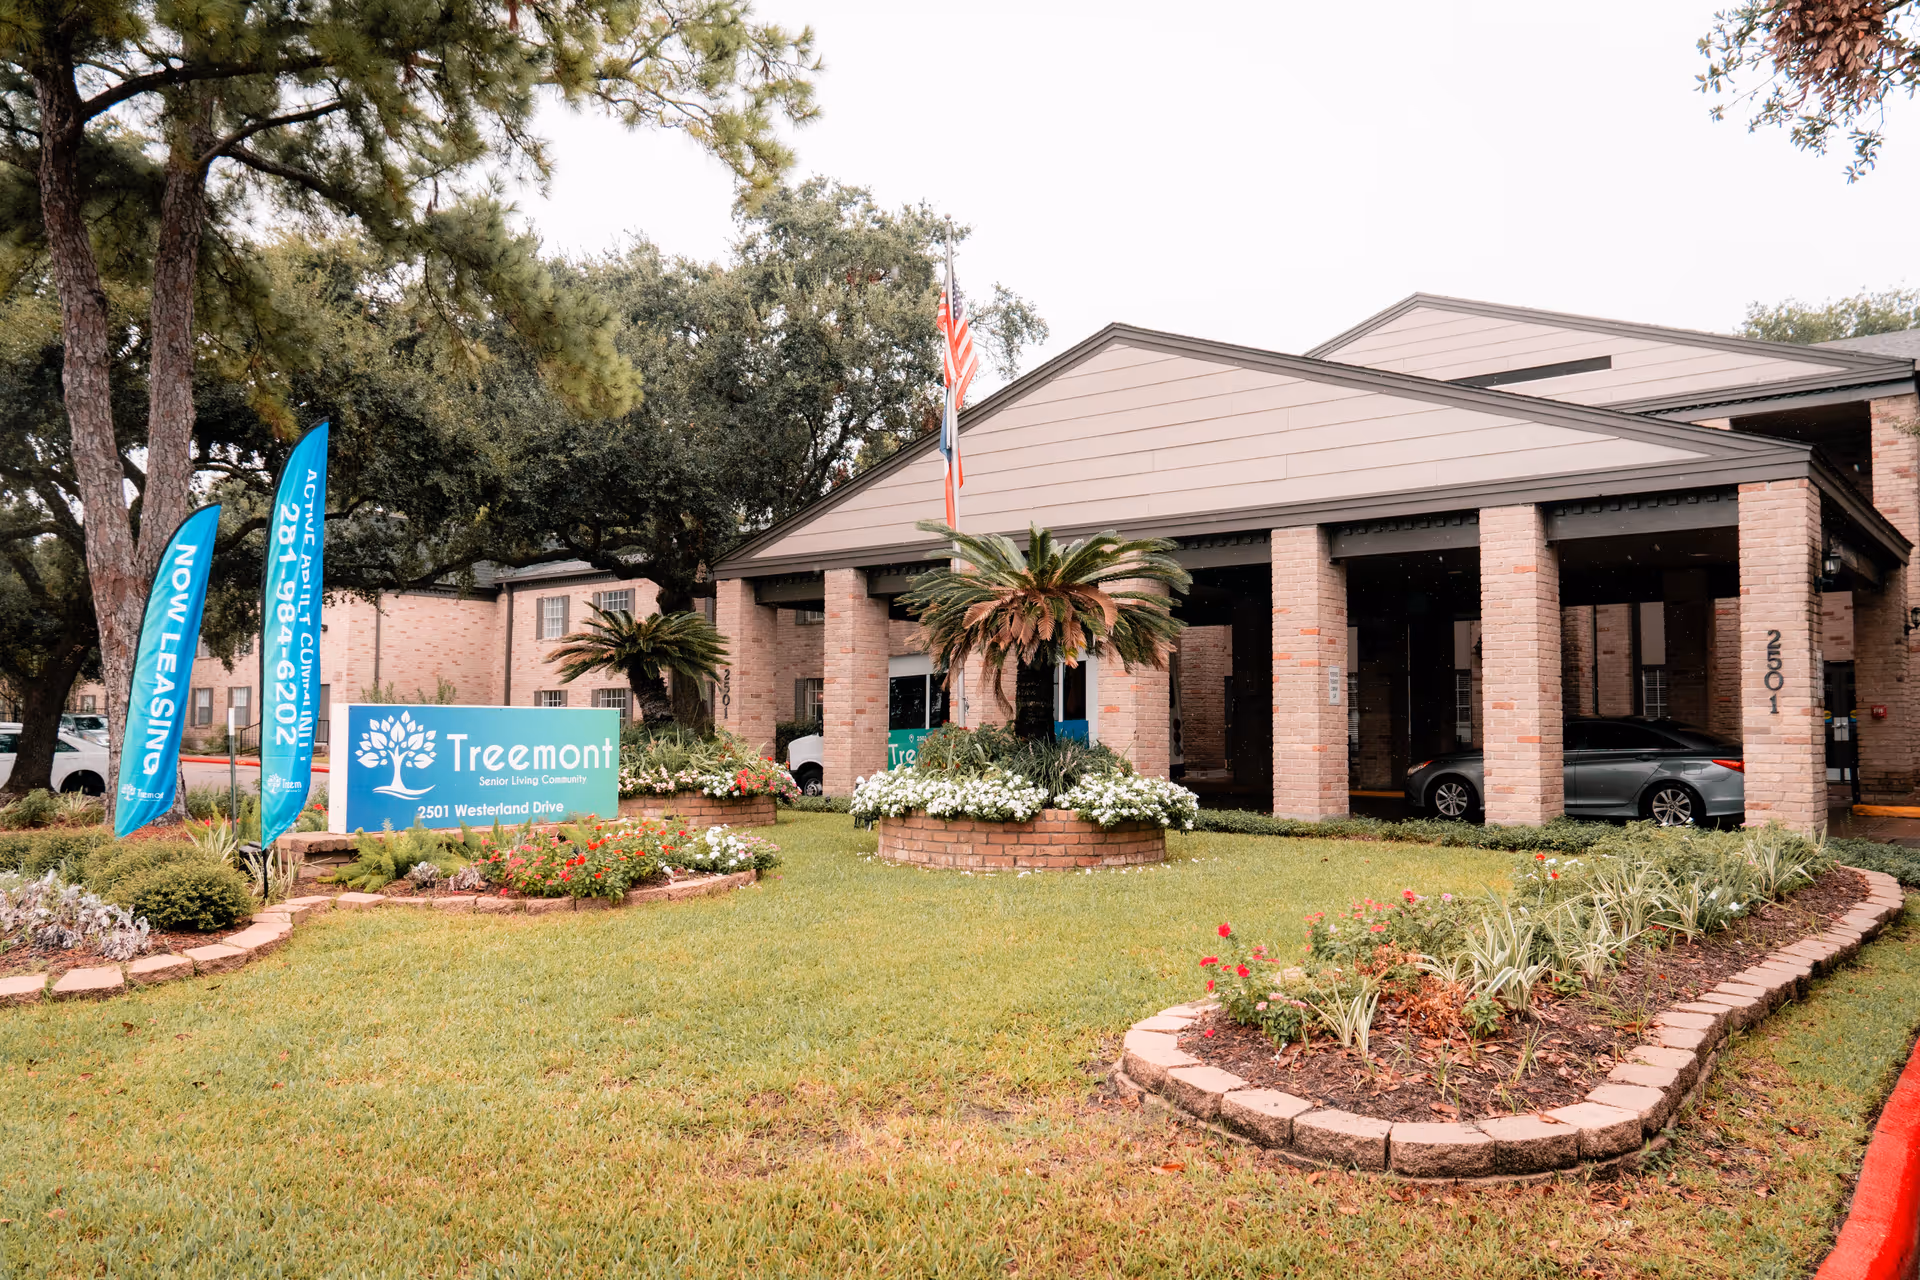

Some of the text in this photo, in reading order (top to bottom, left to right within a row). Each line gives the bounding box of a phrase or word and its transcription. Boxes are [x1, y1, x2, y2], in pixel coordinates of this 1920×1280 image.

[303, 468, 318, 546] ACTIVE
[167, 543, 198, 624] NOW
[275, 502, 300, 746] 281-984-6202
[143, 632, 181, 776] LEASING
[722, 668, 731, 720] 2501
[1763, 629, 1785, 715] 2501
[446, 733, 613, 772] Treemont
[478, 774, 587, 787] Senior Living Community
[417, 800, 564, 819] 2501 Westerland Drive
